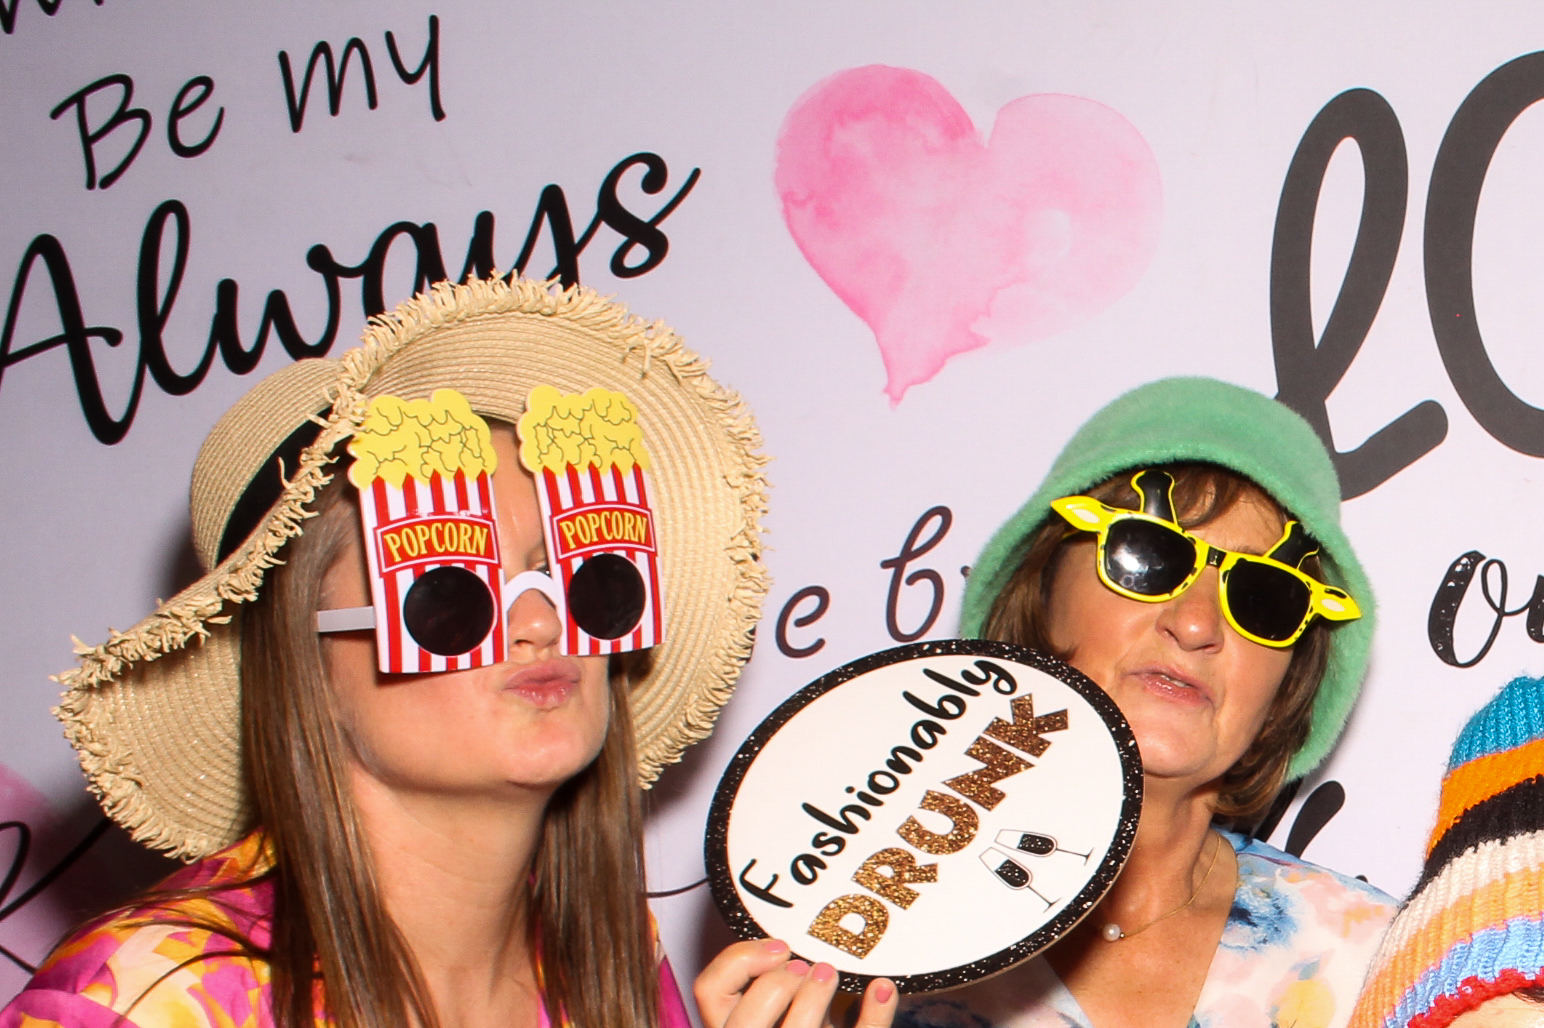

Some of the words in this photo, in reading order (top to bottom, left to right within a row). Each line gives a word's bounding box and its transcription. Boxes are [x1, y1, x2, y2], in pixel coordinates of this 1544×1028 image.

[51, 73, 225, 190] Be
[279, 15, 447, 133] my
[384, 521, 489, 562] POPCORN
[560, 511, 648, 549] POPCORN
[739, 659, 1018, 908] Fashionably
[807, 692, 1069, 960] DRUNK
